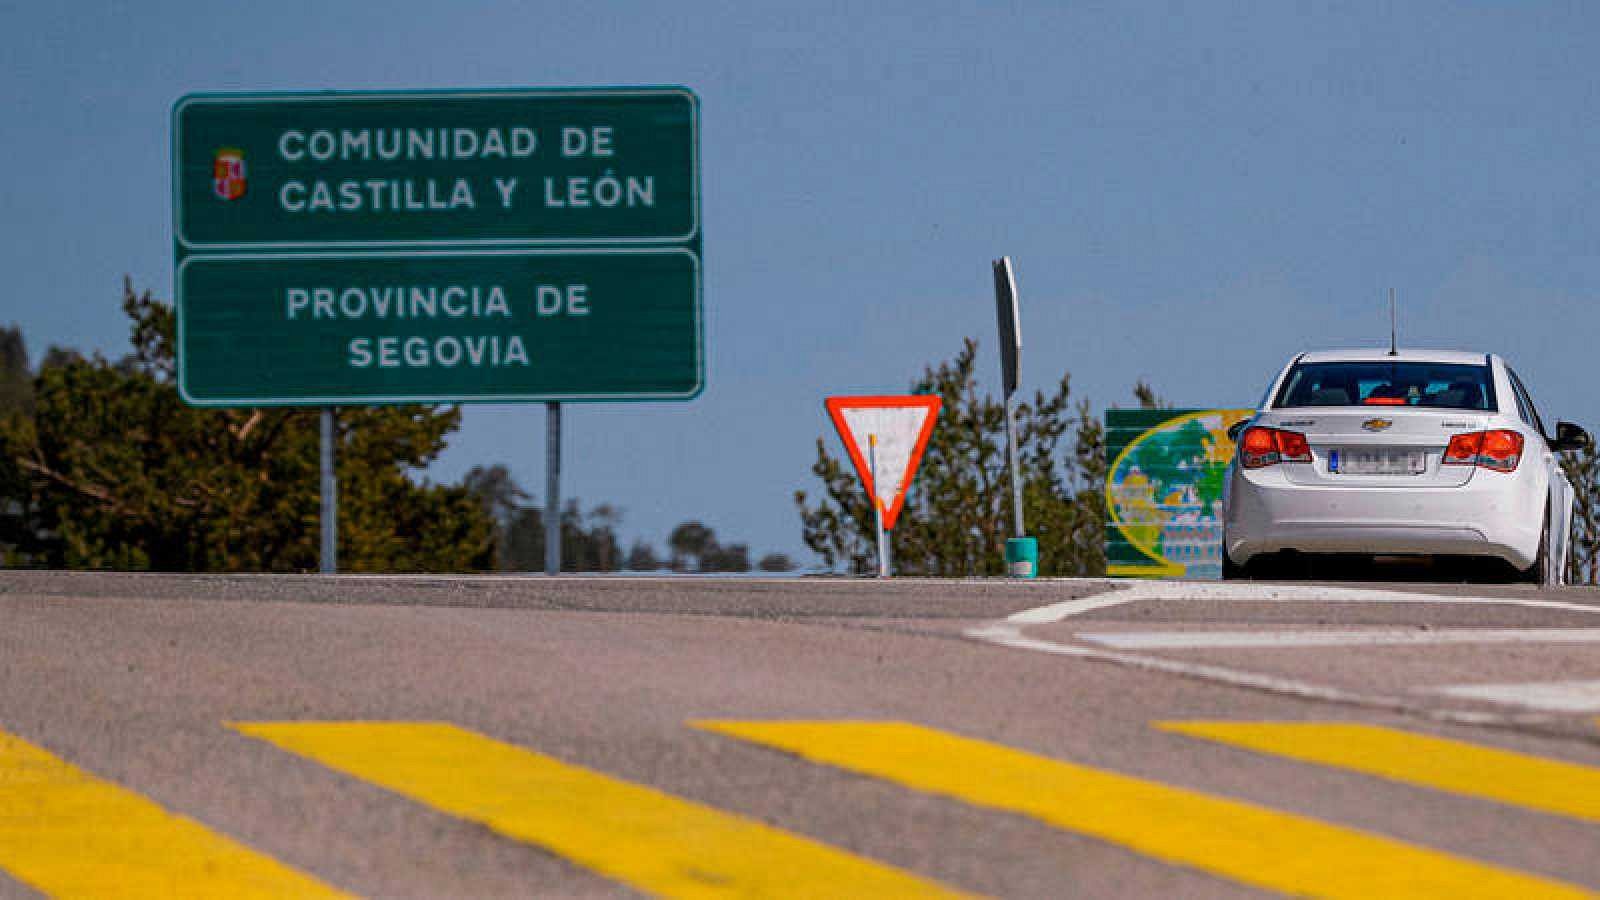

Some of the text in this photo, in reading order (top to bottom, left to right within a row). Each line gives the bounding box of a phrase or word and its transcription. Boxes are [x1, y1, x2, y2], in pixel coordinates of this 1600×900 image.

[279, 127, 614, 160] COMUNIDAD DE
[280, 170, 654, 211] CASTILLA Y LEÓN
[286, 285, 591, 319] PROVINCIA DE
[348, 337, 530, 367] SEGOVIA
